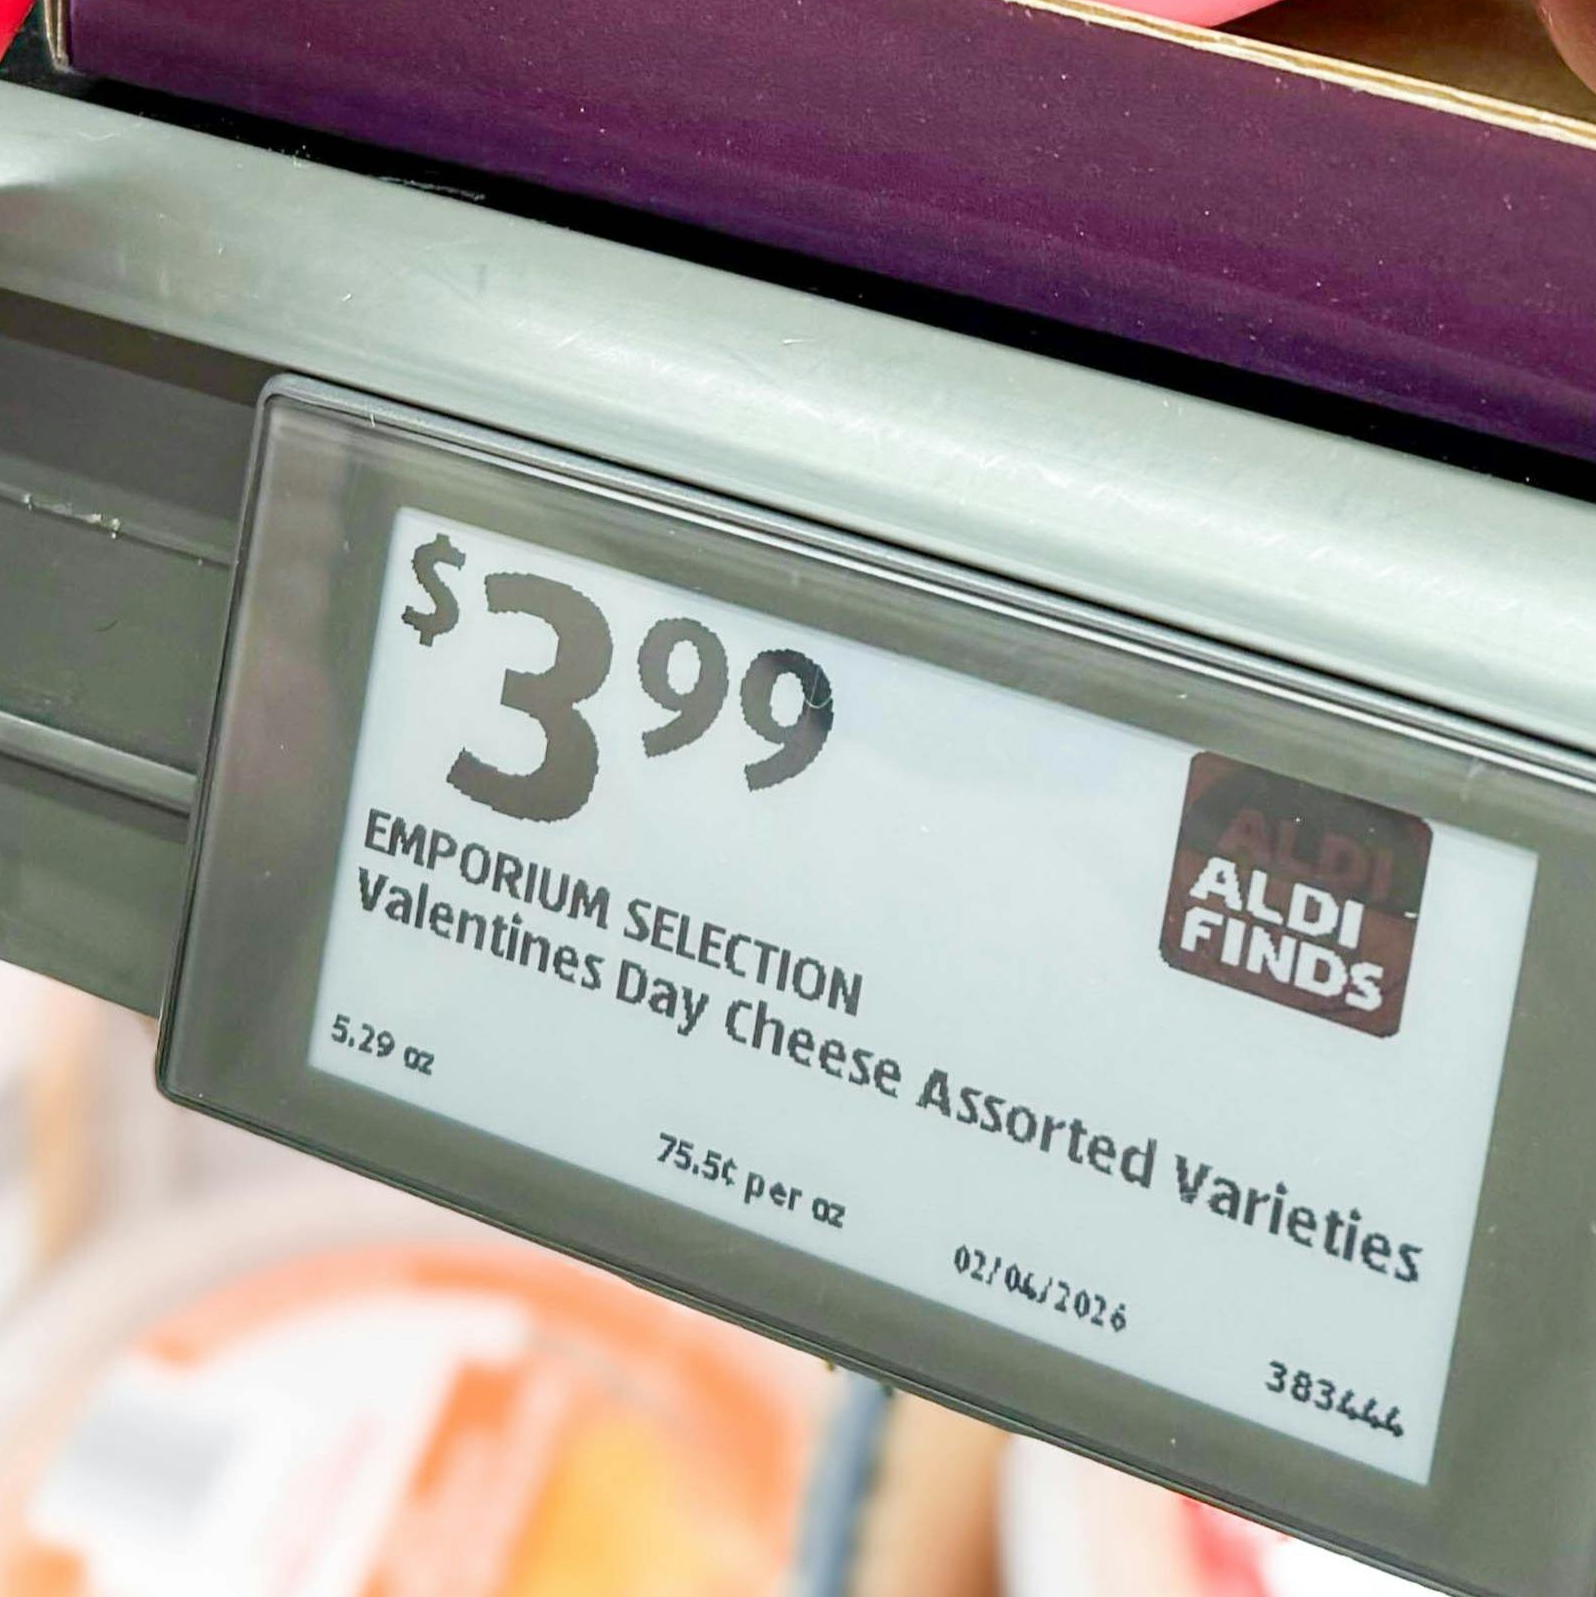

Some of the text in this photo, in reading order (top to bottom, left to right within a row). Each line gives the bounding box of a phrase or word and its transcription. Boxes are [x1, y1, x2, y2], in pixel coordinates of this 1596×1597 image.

[363, 808, 863, 1016] EMPORIUM SELECTION
[1188, 855, 1364, 951] ALDI
[1178, 906, 1385, 1012] FINDS
[329, 1014, 435, 1076] 5.29 oz
[356, 865, 1424, 1284] Valentines Day Cheese Assorted Varieties
[656, 1131, 846, 1229] 75.5¢ per oz
